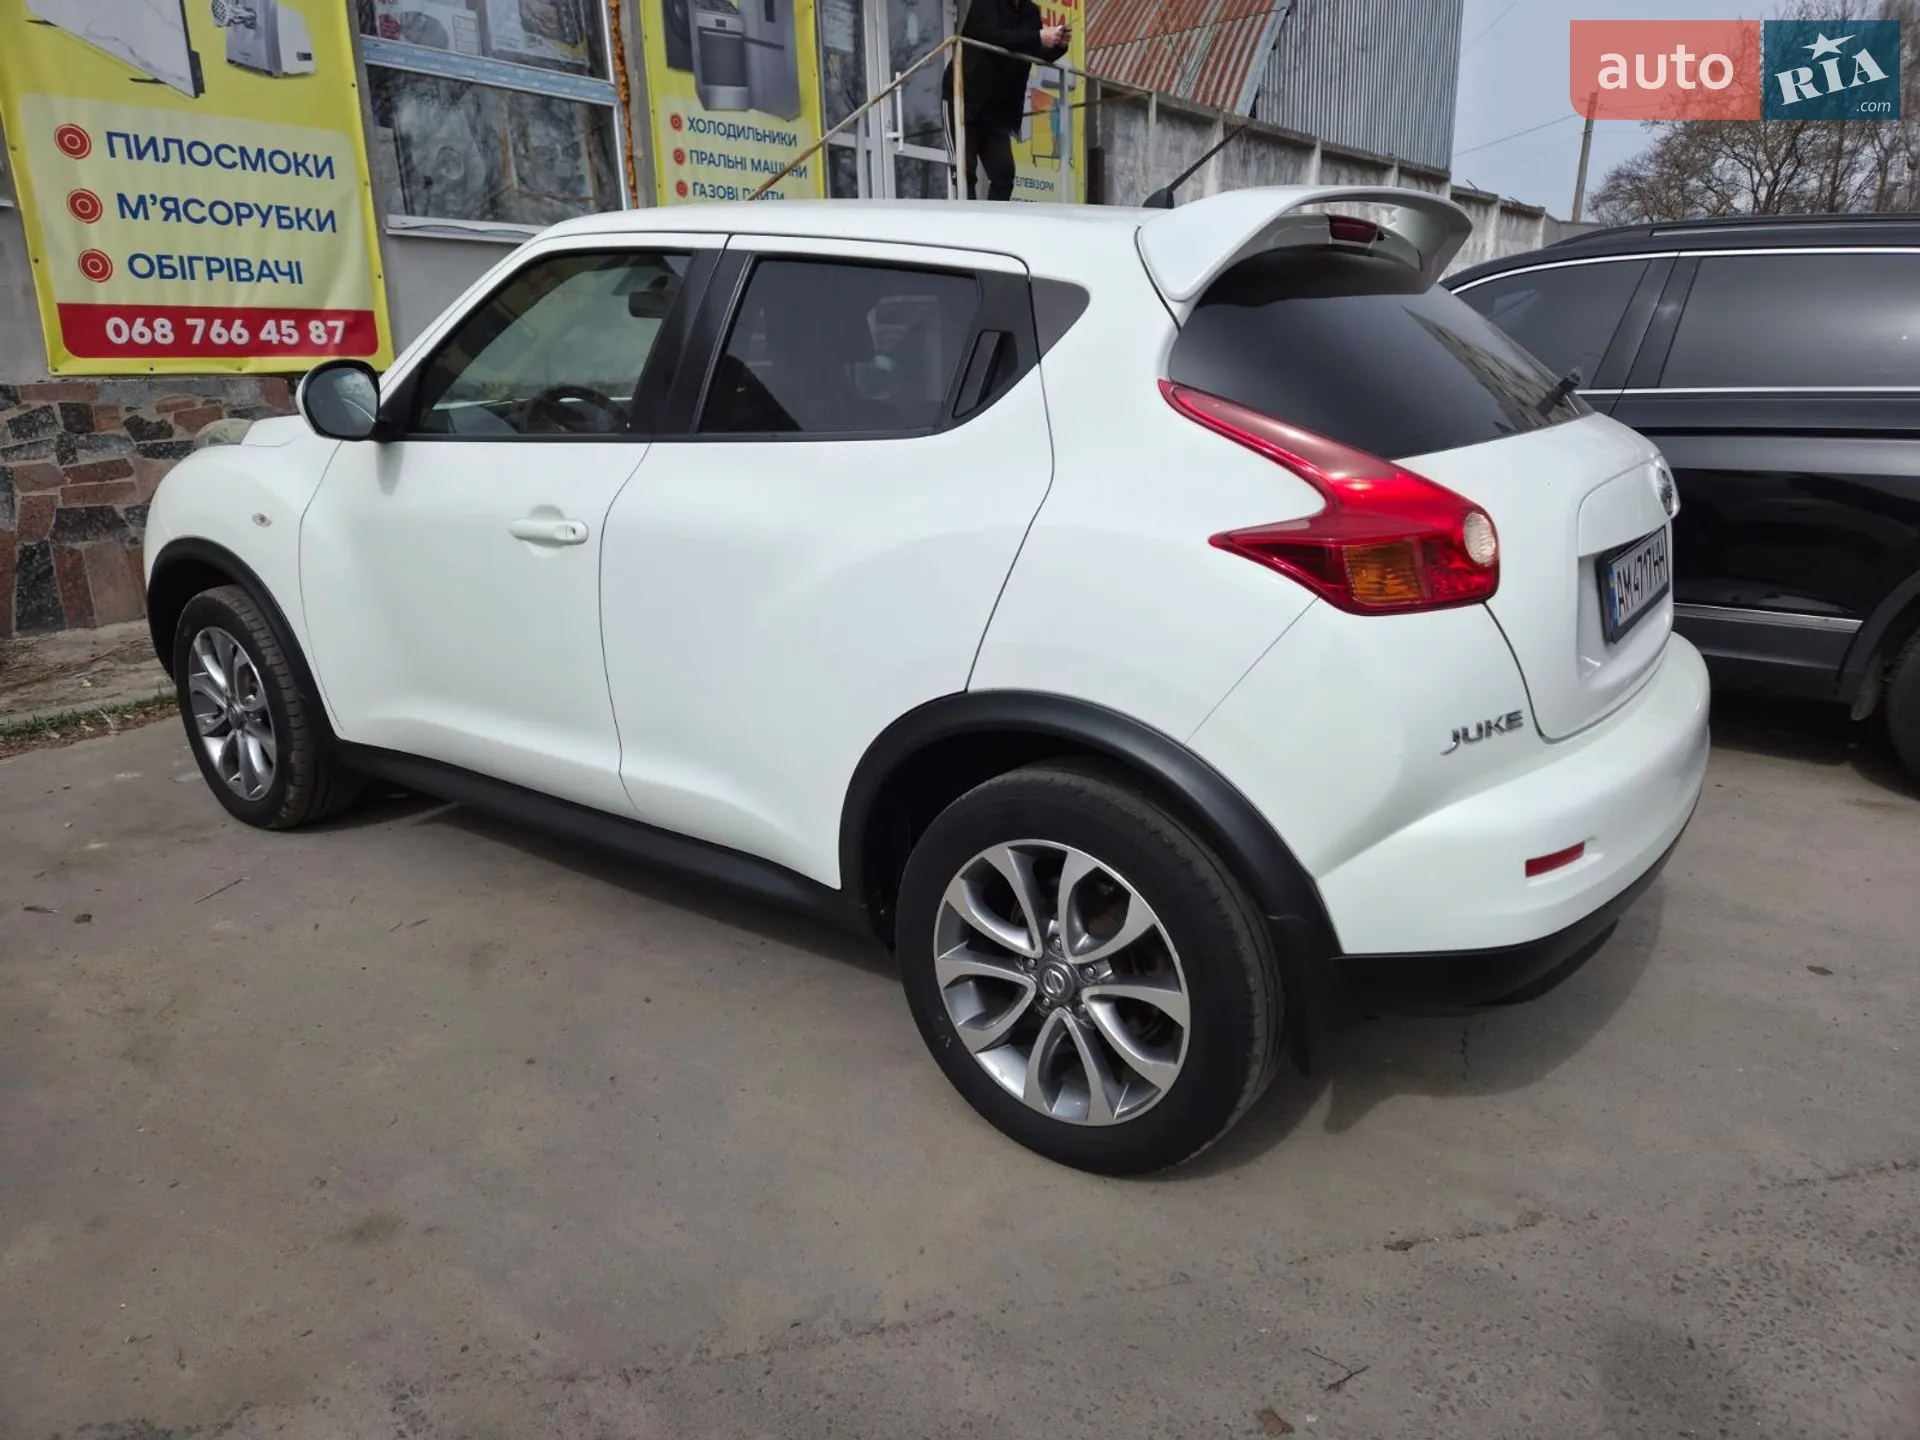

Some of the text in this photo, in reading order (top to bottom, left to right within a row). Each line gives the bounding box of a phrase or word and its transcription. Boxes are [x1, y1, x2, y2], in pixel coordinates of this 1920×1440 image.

[687, 116, 797, 147] ХОЛОДИЛЬНИКИ
[106, 130, 336, 180] ПИЛОСМОКИ
[689, 149, 747, 170] ПРАЛЬНІ
[692, 182, 785, 200] ГАЗОВІ ПИТИ
[116, 192, 337, 233] М’ЯСОРУБКИ
[128, 253, 303, 285] ОБІГРІВАЧІ
[106, 316, 345, 345] 068 766 45 87
[1440, 709, 1524, 756] JUKE
